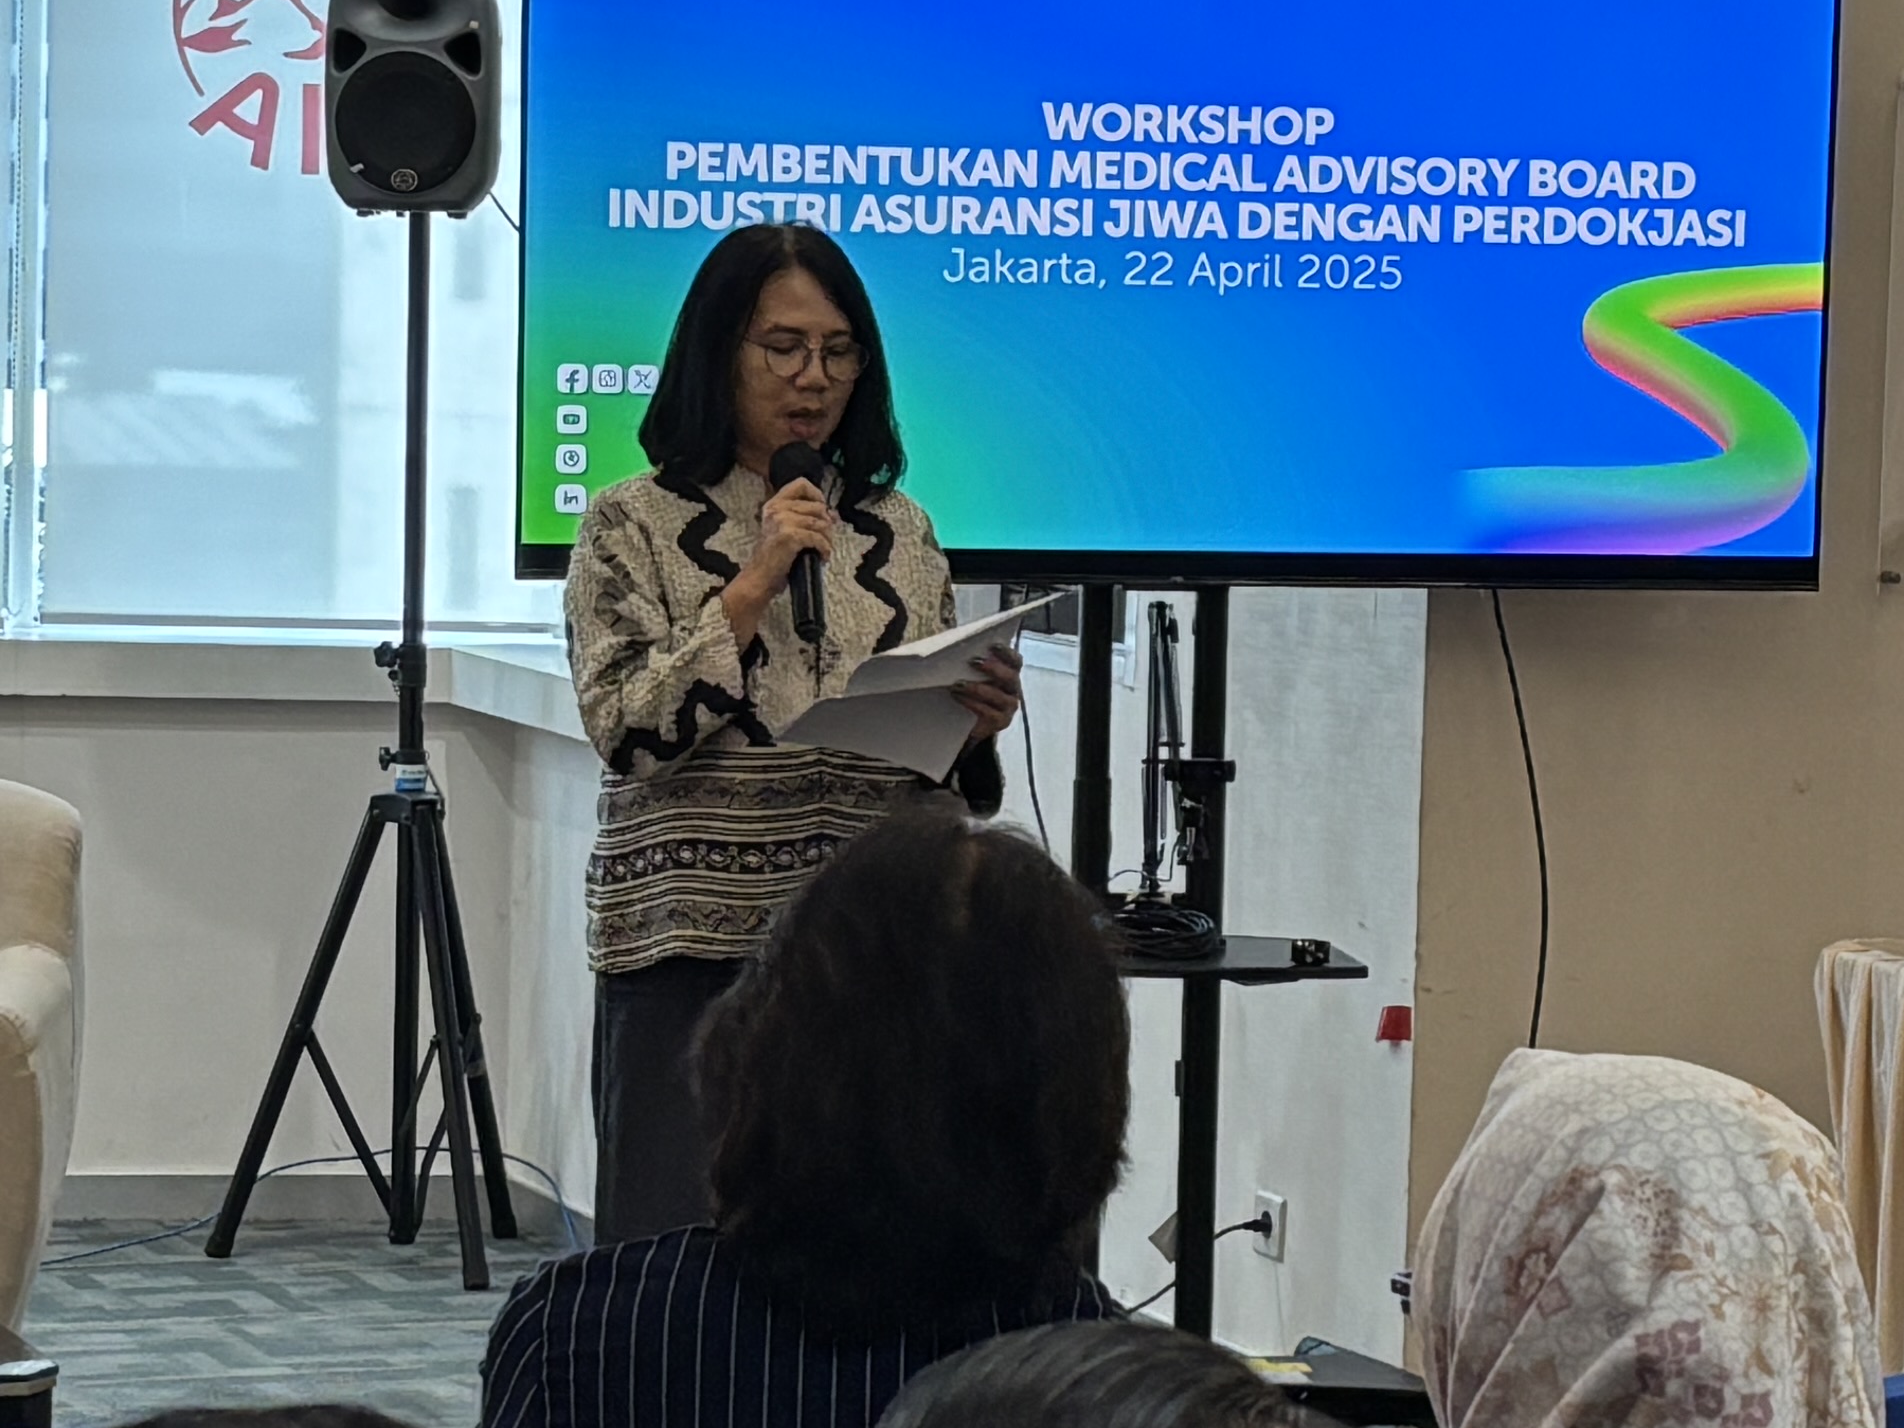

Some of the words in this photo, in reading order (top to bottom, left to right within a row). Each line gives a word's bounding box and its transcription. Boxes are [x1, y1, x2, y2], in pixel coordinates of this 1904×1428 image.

[188, 72, 323, 176] AI
[1042, 101, 1335, 146] WORKSHOP
[666, 141, 1038, 189] PEMBENTUKAN
[1049, 151, 1267, 192] MEDICAL
[1272, 155, 1520, 197] ADVISORY
[1528, 160, 1697, 200] BOARD
[608, 188, 842, 233] INDUSTRI
[849, 194, 1094, 235] ASURANSI
[1102, 199, 1229, 240] JIWA
[1237, 202, 1442, 243] DENGAN
[1453, 205, 1747, 248] PERDOKJASI
[942, 247, 1107, 289] Jakarta,
[1123, 251, 1174, 287] 22
[1187, 252, 1283, 296] April
[1297, 254, 1404, 291] 2025
